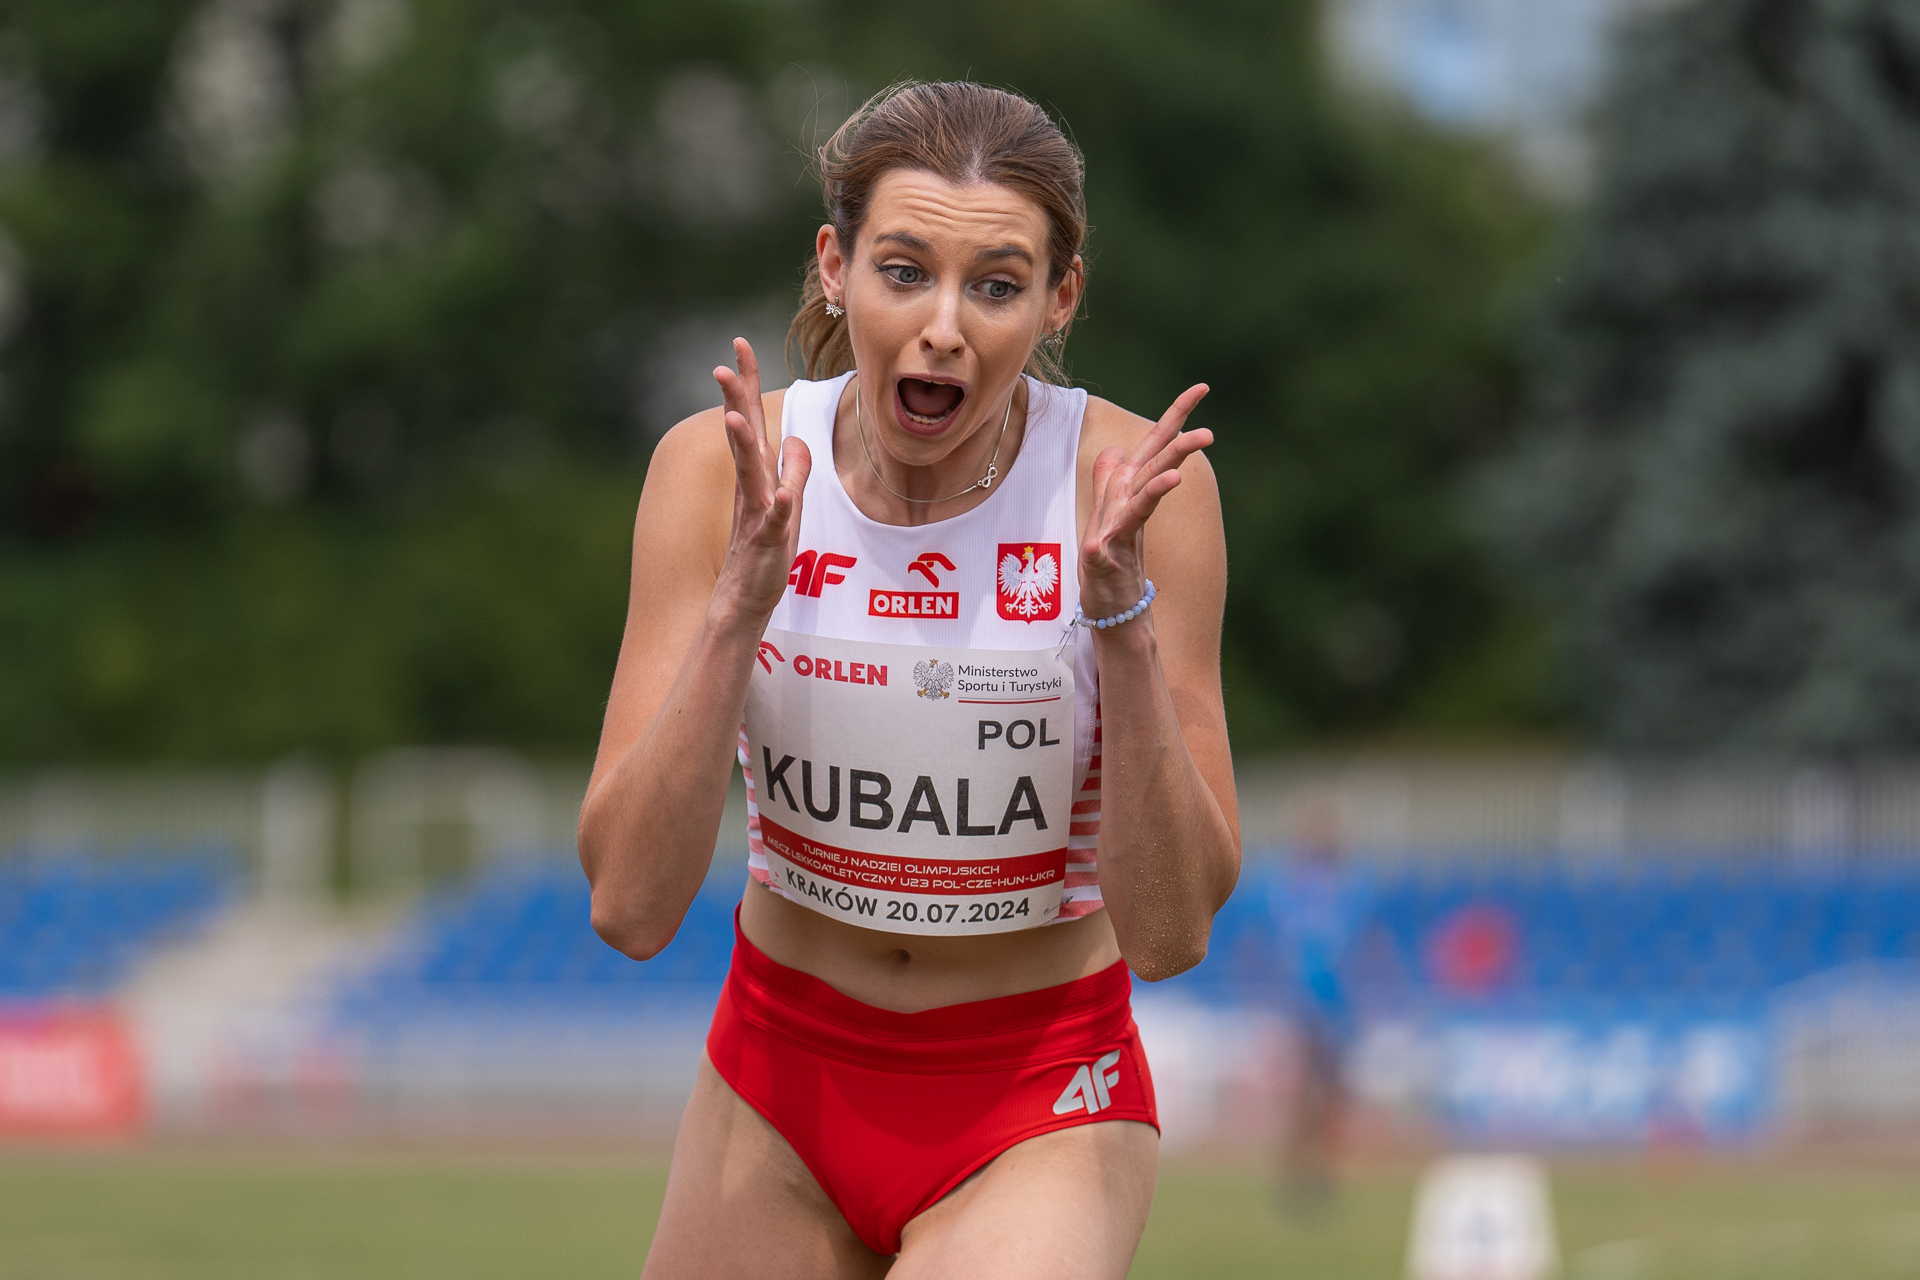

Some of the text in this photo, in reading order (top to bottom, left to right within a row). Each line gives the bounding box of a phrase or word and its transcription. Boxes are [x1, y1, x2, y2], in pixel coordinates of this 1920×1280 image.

[873, 594, 954, 616] ORLEN
[793, 654, 888, 687] ORLEN
[957, 677, 1062, 693] Sportu i Turystyki
[958, 664, 1038, 678] Ministerstwo
[978, 718, 1061, 750] POL
[762, 745, 1049, 837] KUBALA
[767, 835, 1056, 889] MECZ LEKKOATLETYCZNY U23 POL-CZE-HUN-UKR
[802, 842, 1000, 876] TURNIEJ NADZIEI OLIMPIJSKICH
[785, 867, 1030, 924] KRAKÓW 20.07.2024
[1052, 1048, 1121, 1115] 4F
